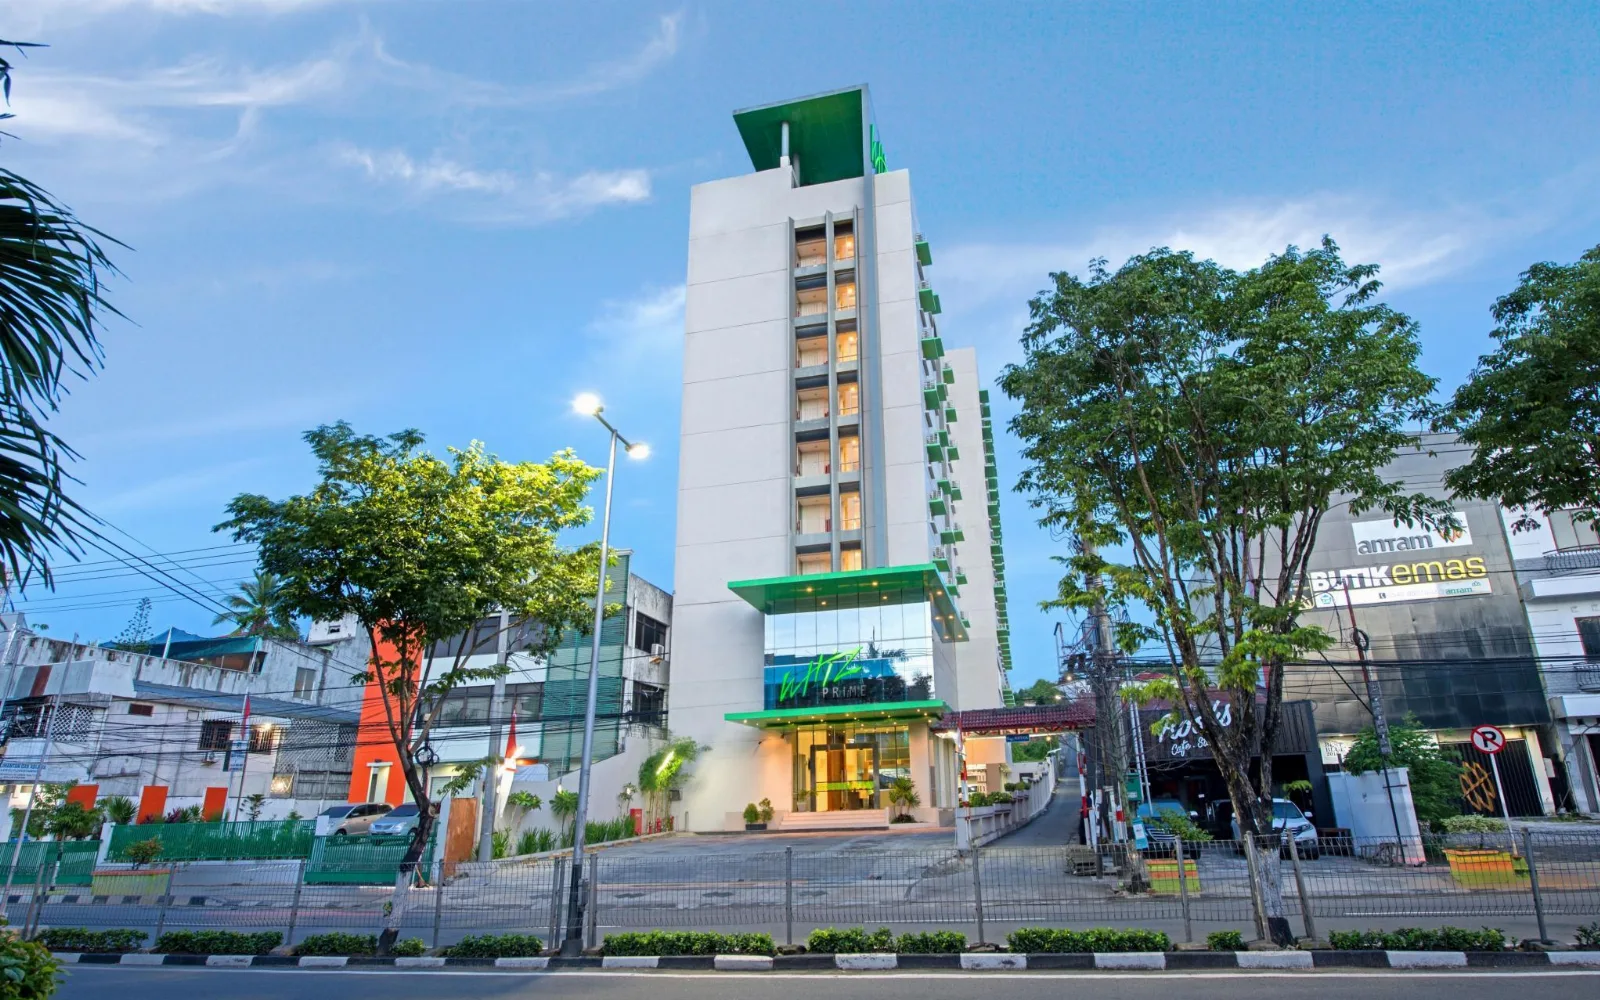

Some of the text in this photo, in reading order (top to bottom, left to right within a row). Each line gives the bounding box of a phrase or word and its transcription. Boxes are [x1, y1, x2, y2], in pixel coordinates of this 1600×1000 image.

[1358, 534, 1434, 555] antam
[1391, 556, 1487, 585] emas
[822, 684, 867, 699] PRIME
[1481, 730, 1497, 748] P
